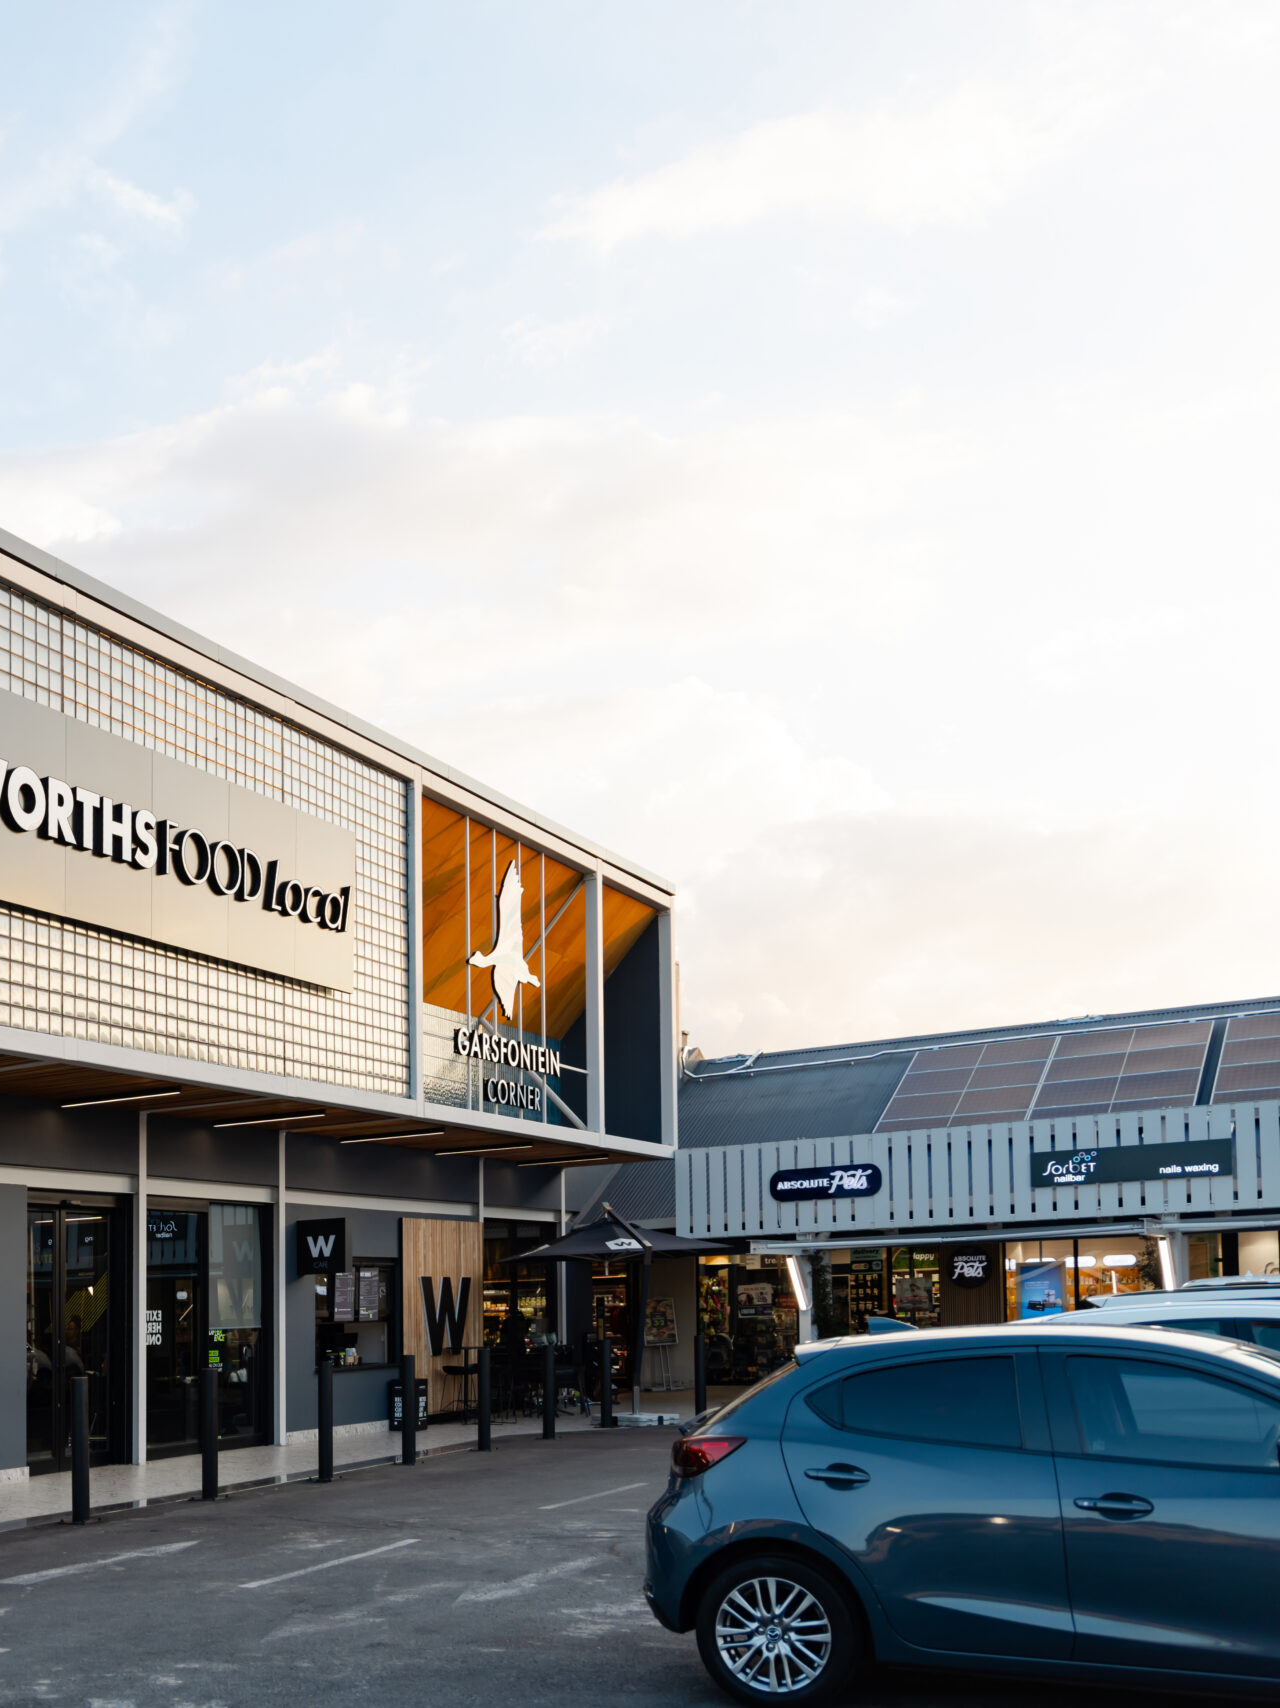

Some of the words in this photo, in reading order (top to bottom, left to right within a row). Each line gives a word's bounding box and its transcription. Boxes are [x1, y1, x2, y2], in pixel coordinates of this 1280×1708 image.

[156, 819, 263, 903] FOOD
[264, 859, 352, 933] Local
[455, 1026, 561, 1078] GARSFONTEIN
[485, 1077, 542, 1112] CORNER
[776, 1177, 831, 1191] ABSOLUTE
[827, 1168, 873, 1194] Pets
[1053, 1173, 1086, 1183] nailbar
[1159, 1164, 1182, 1175] nails
[1184, 1162, 1220, 1174] waxing
[305, 1234, 336, 1259] W
[952, 1261, 988, 1280] Pets
[419, 1276, 472, 1357] W
